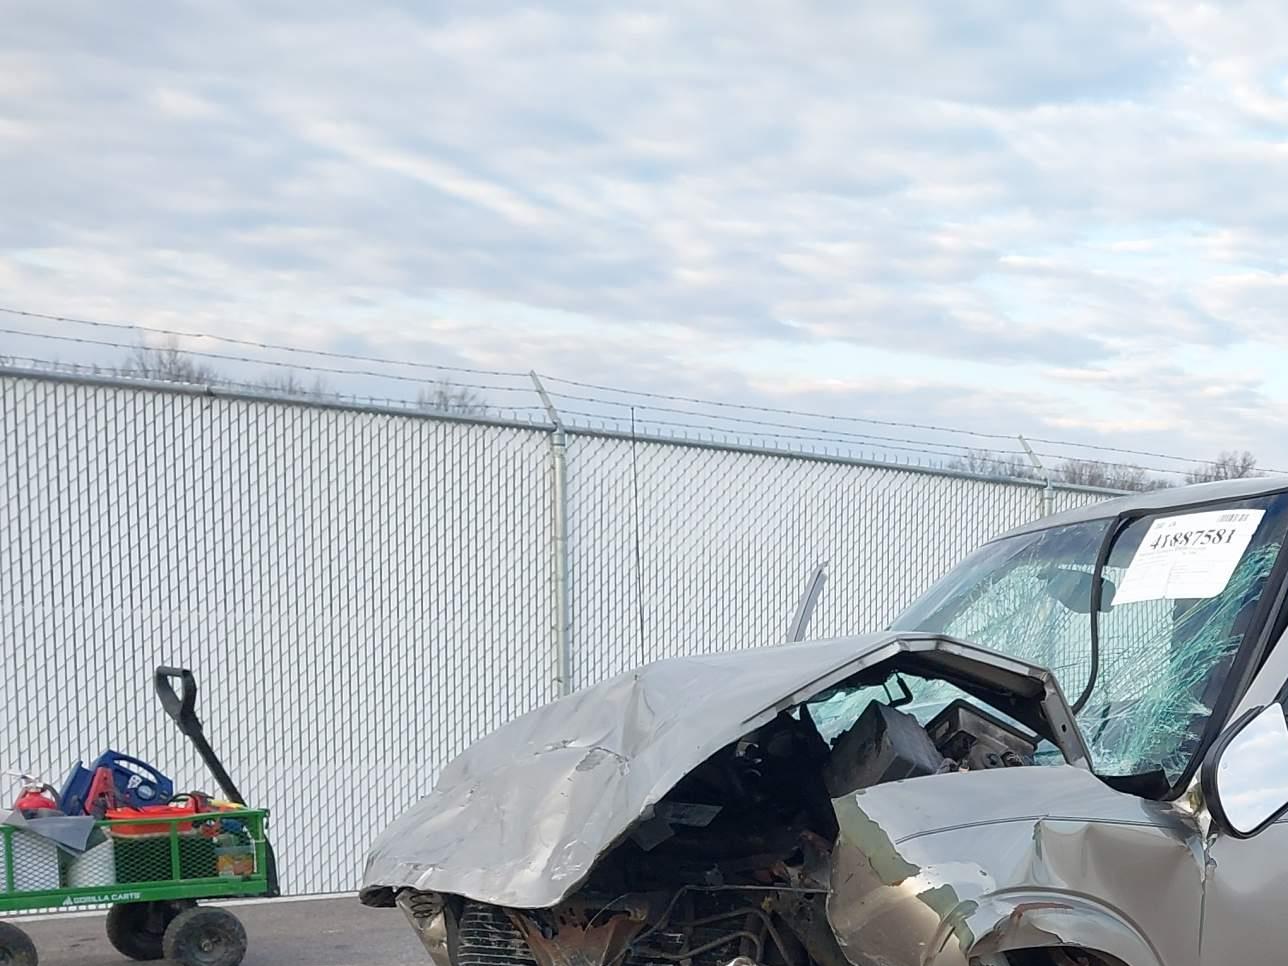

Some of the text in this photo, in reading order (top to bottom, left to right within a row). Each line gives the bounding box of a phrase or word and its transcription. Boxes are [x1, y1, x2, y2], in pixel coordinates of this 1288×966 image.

[1150, 528, 1236, 550] 41887581
[73, 892, 140, 904] GORILLA CARTS
